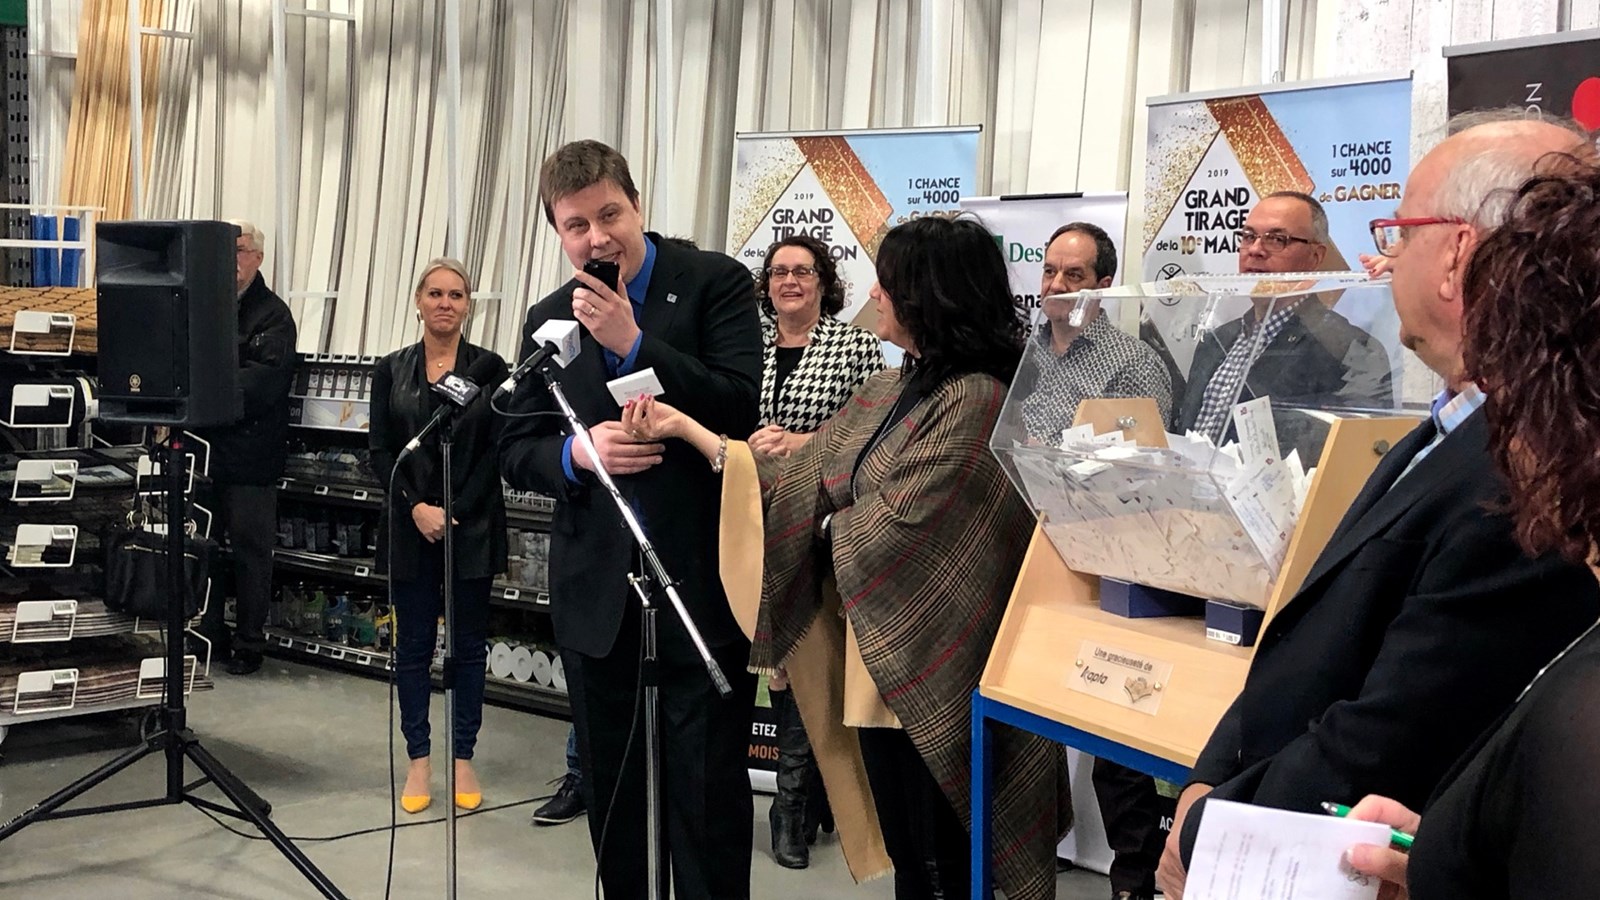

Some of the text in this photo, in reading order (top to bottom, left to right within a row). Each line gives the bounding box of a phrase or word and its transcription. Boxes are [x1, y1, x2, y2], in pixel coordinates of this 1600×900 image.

[1332, 141, 1392, 158] 1 CHANCE
[1207, 169, 1229, 178] 2019
[1331, 157, 1391, 178] sur 4000
[908, 177, 960, 189] 1 CHANCE
[923, 190, 960, 204] 4000
[1185, 187, 1250, 209] GRAND
[1319, 183, 1401, 203] de GAGNER
[772, 208, 834, 224] GRAND
[1184, 209, 1249, 231] TIRAGE
[772, 226, 833, 241] TIRAGE
[744, 248, 756, 257] de
[757, 248, 765, 257] la
[1009, 242, 1047, 262] Des
[1156, 240, 1168, 251] de
[1169, 240, 1178, 250] la
[1094, 647, 1107, 658] Une
[1144, 662, 1153, 671] de
[752, 722, 777, 737] ETEZ
[748, 744, 780, 760] MOIS
